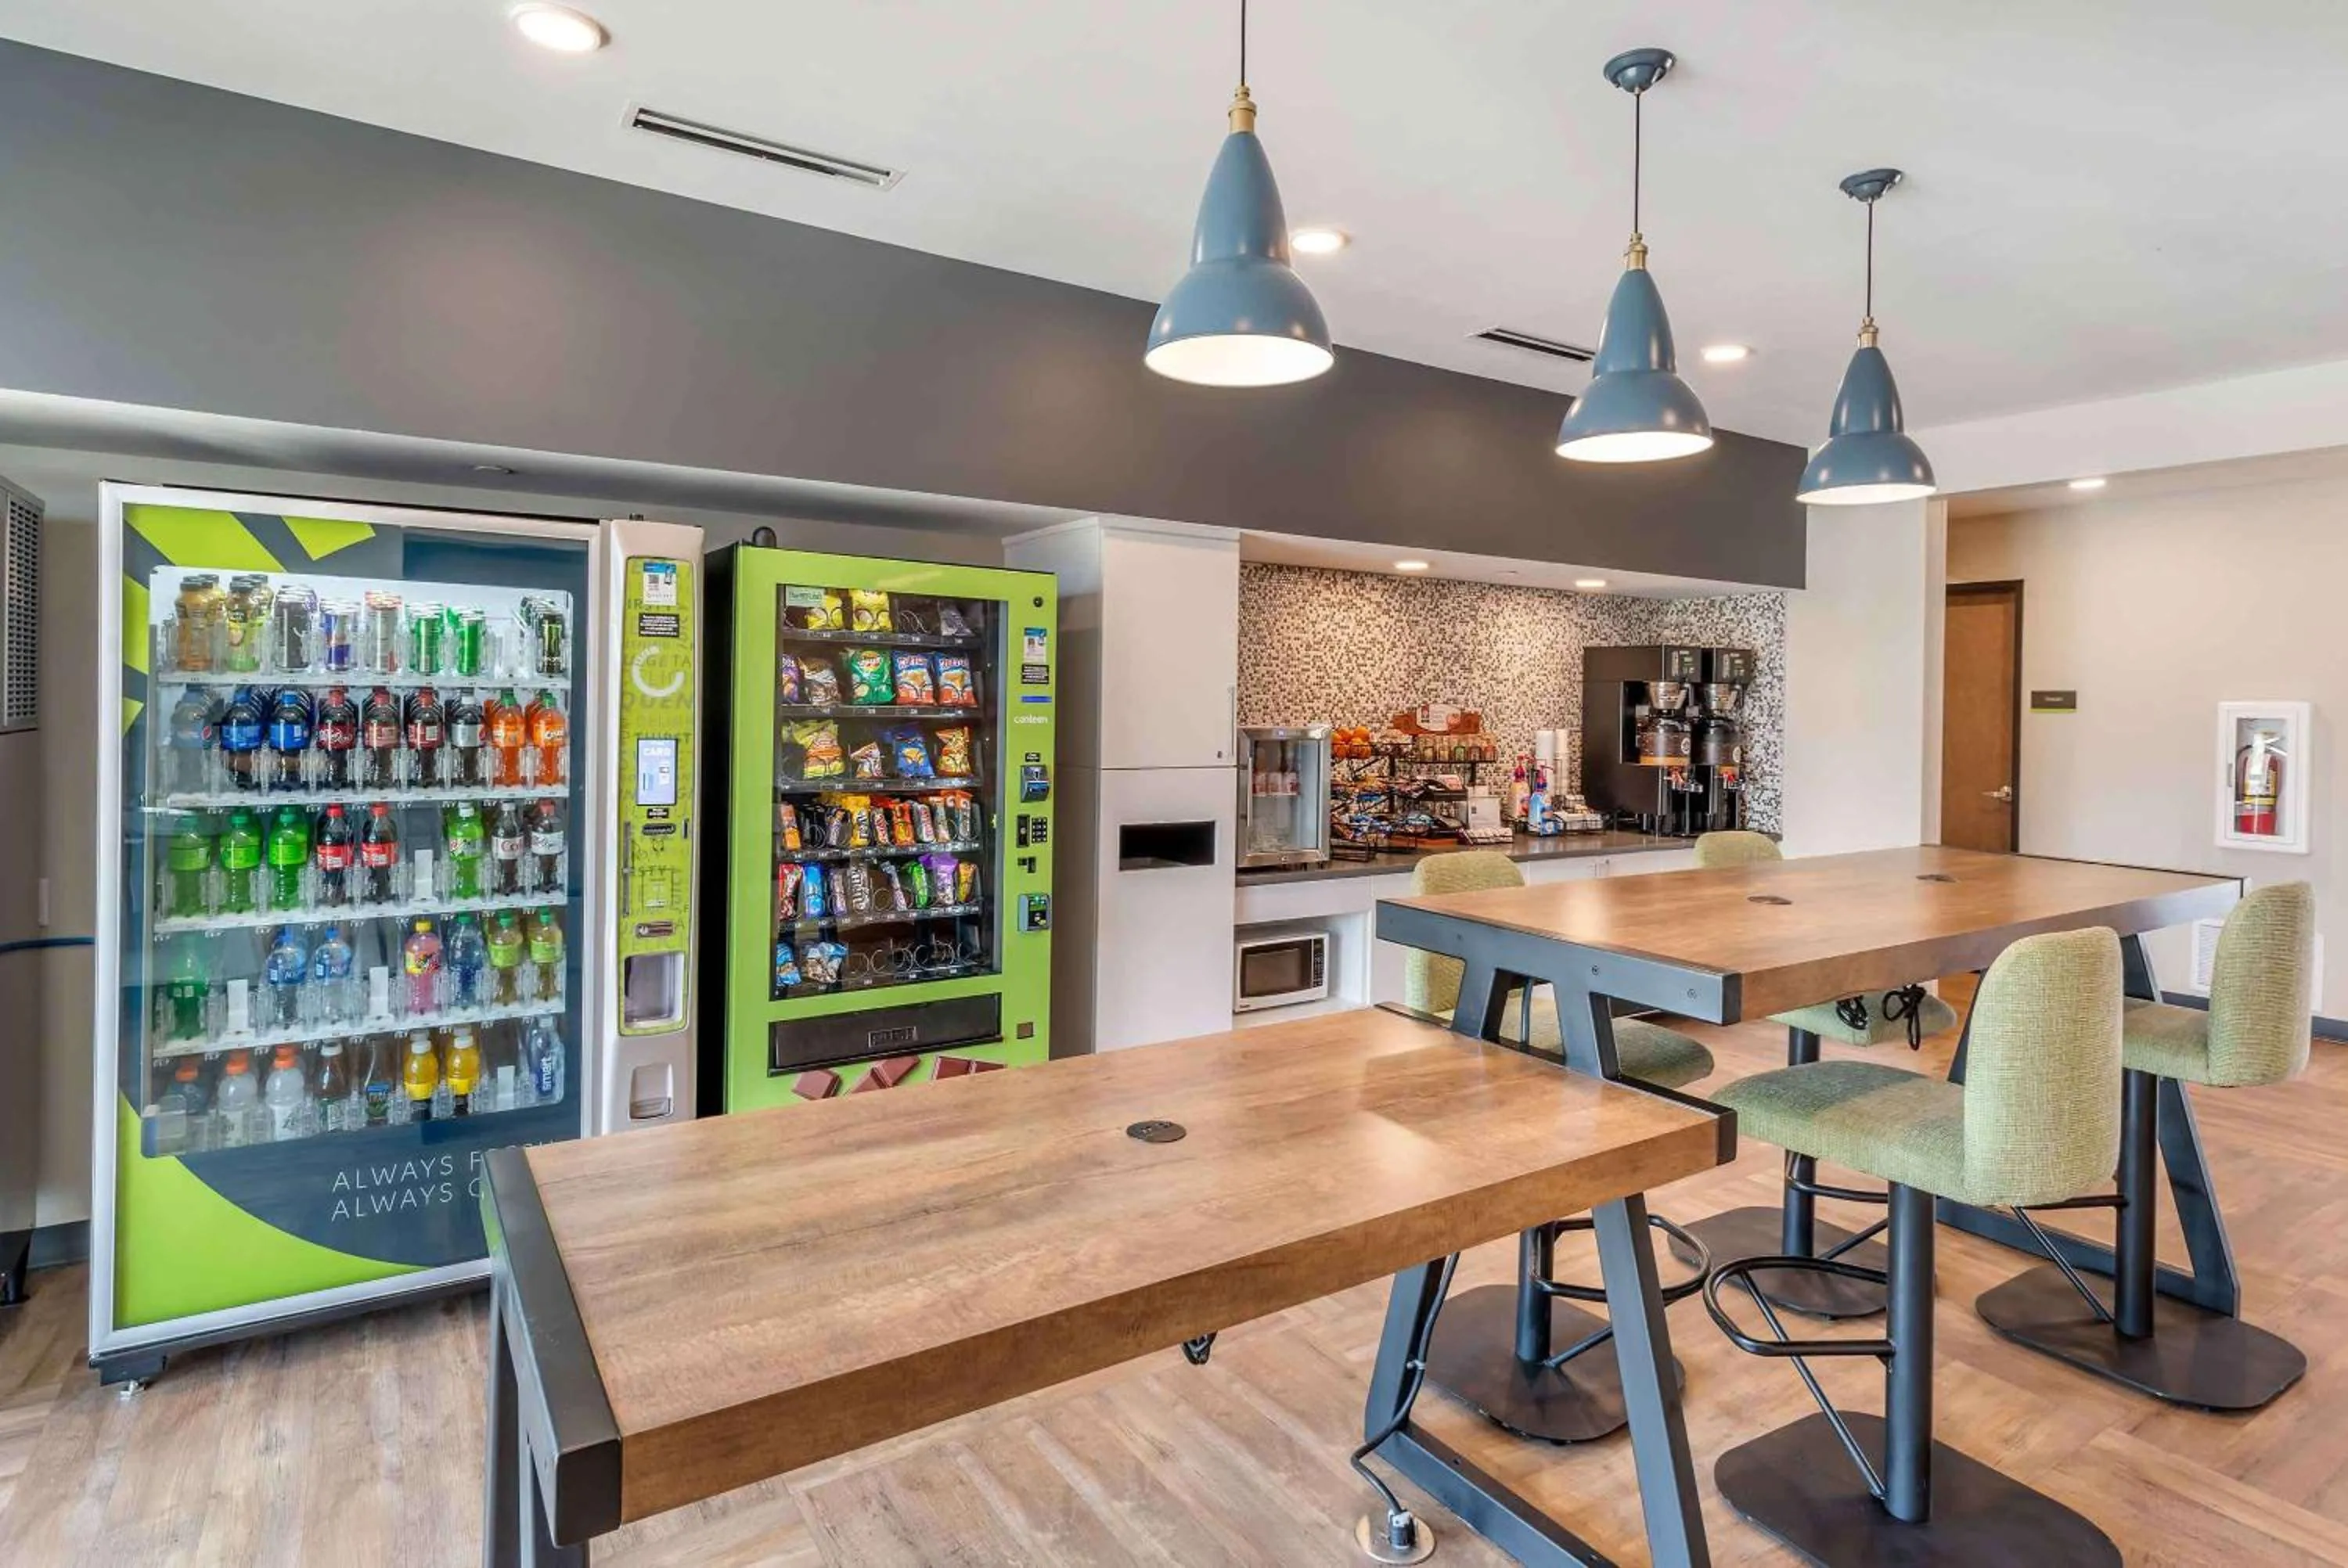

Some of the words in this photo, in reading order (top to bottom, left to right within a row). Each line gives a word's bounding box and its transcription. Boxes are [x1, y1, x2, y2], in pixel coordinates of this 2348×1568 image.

[1014, 714, 1048, 724] canteen
[643, 746, 672, 757] CARD
[541, 1057, 553, 1091] smart
[333, 1156, 454, 1193] ALWAYS
[331, 1182, 453, 1222] ALWAYS
